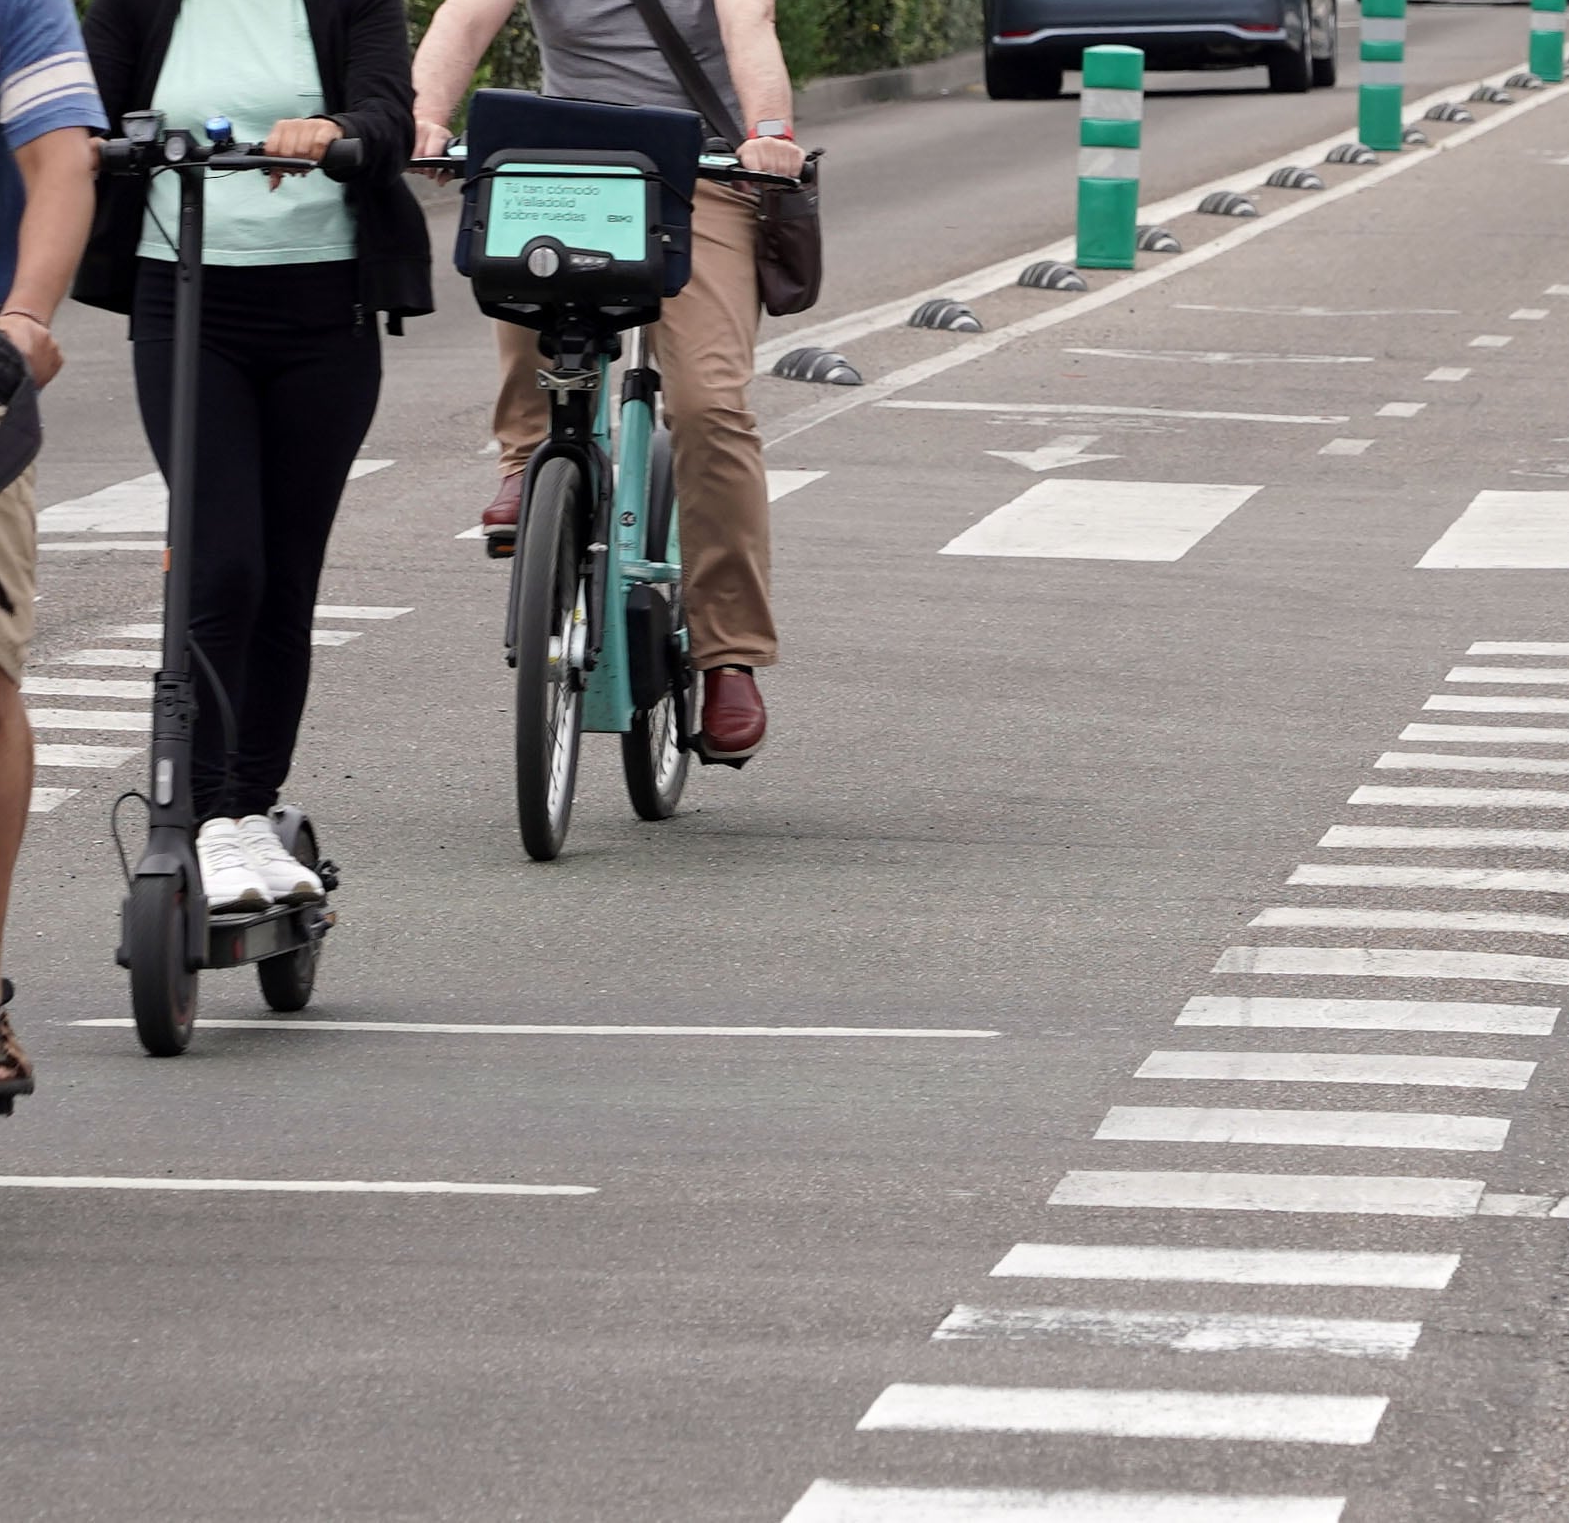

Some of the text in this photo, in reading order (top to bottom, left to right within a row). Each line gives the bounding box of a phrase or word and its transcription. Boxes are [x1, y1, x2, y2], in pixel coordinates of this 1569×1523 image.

[515, 196, 576, 208] Valladolid
[503, 210, 587, 222] sobre ruedas
